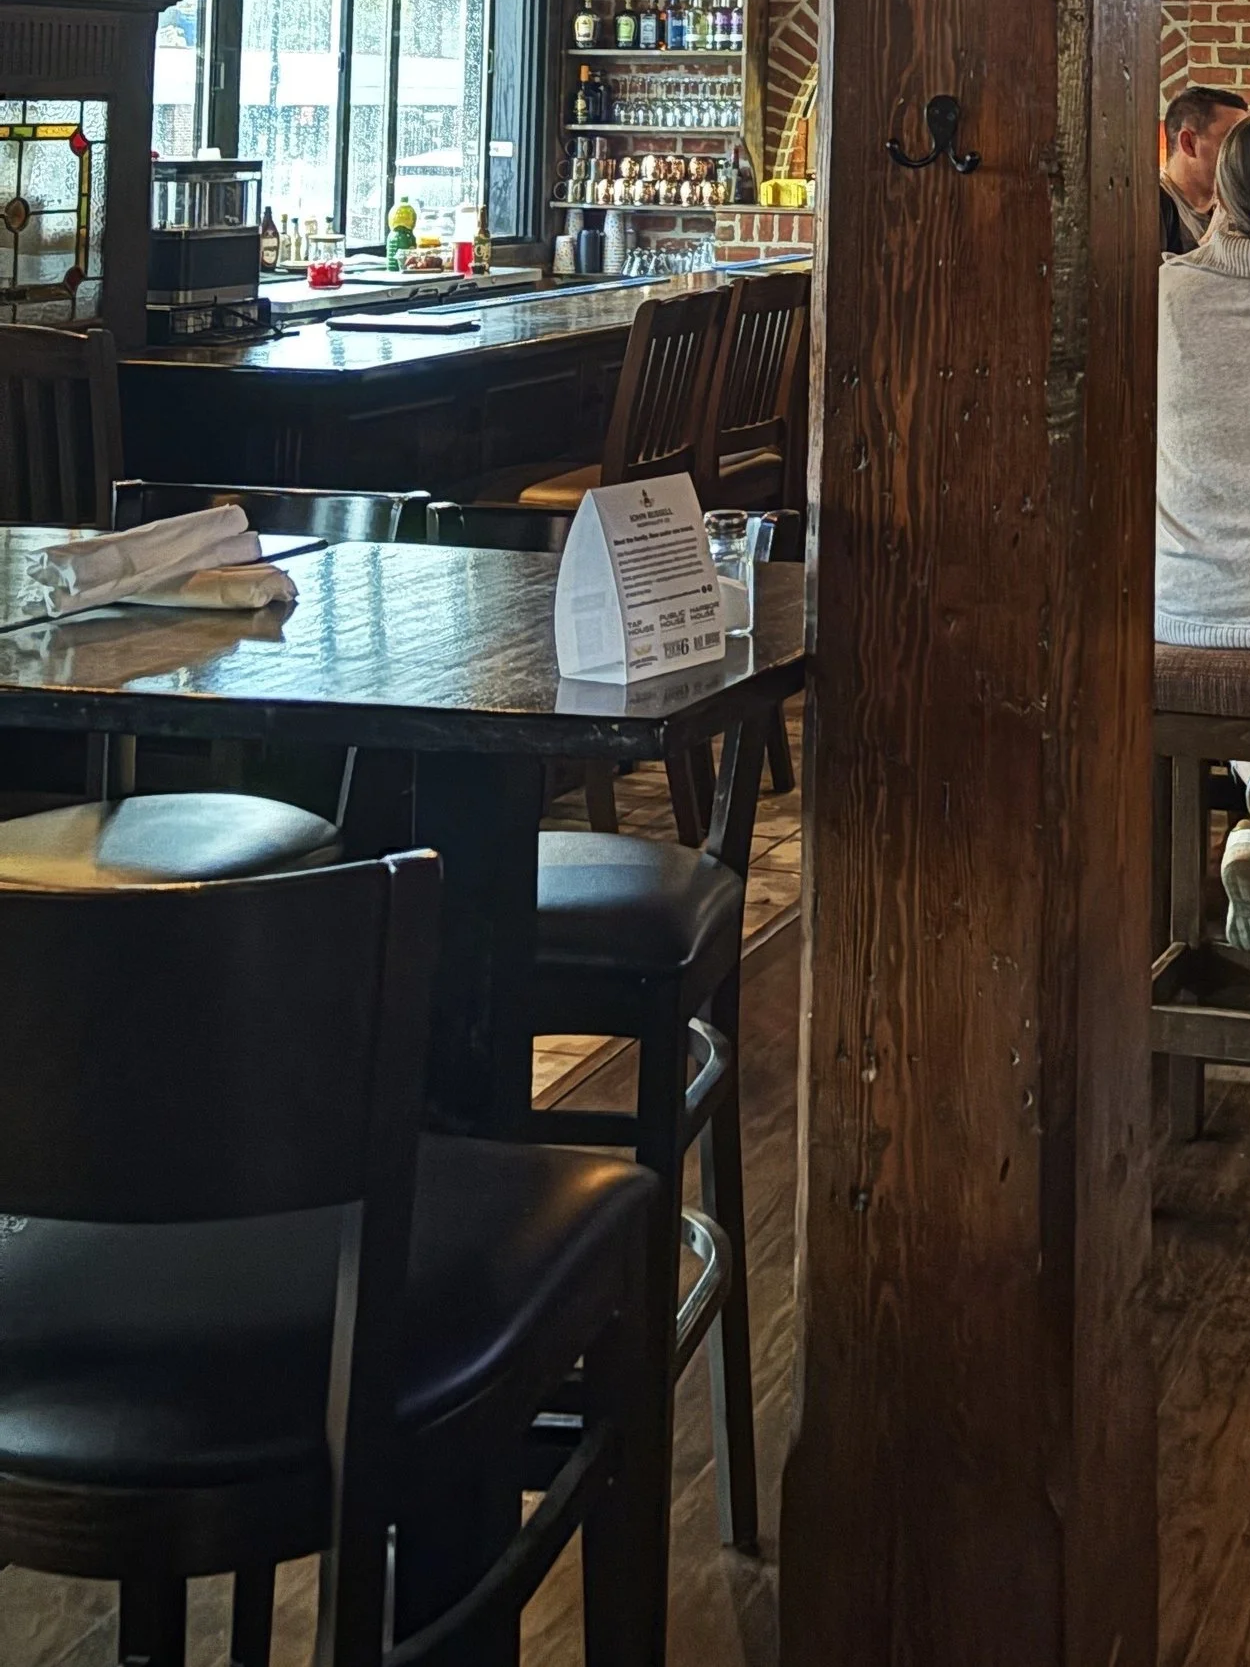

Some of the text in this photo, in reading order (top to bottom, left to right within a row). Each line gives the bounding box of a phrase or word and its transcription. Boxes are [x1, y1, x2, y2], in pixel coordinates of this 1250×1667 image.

[659, 609, 685, 620] PUBLIC
[690, 609, 715, 620] HOUSE
[627, 620, 642, 628] TAP
[660, 617, 685, 627] HOUSE
[628, 624, 654, 636] HOUSE
